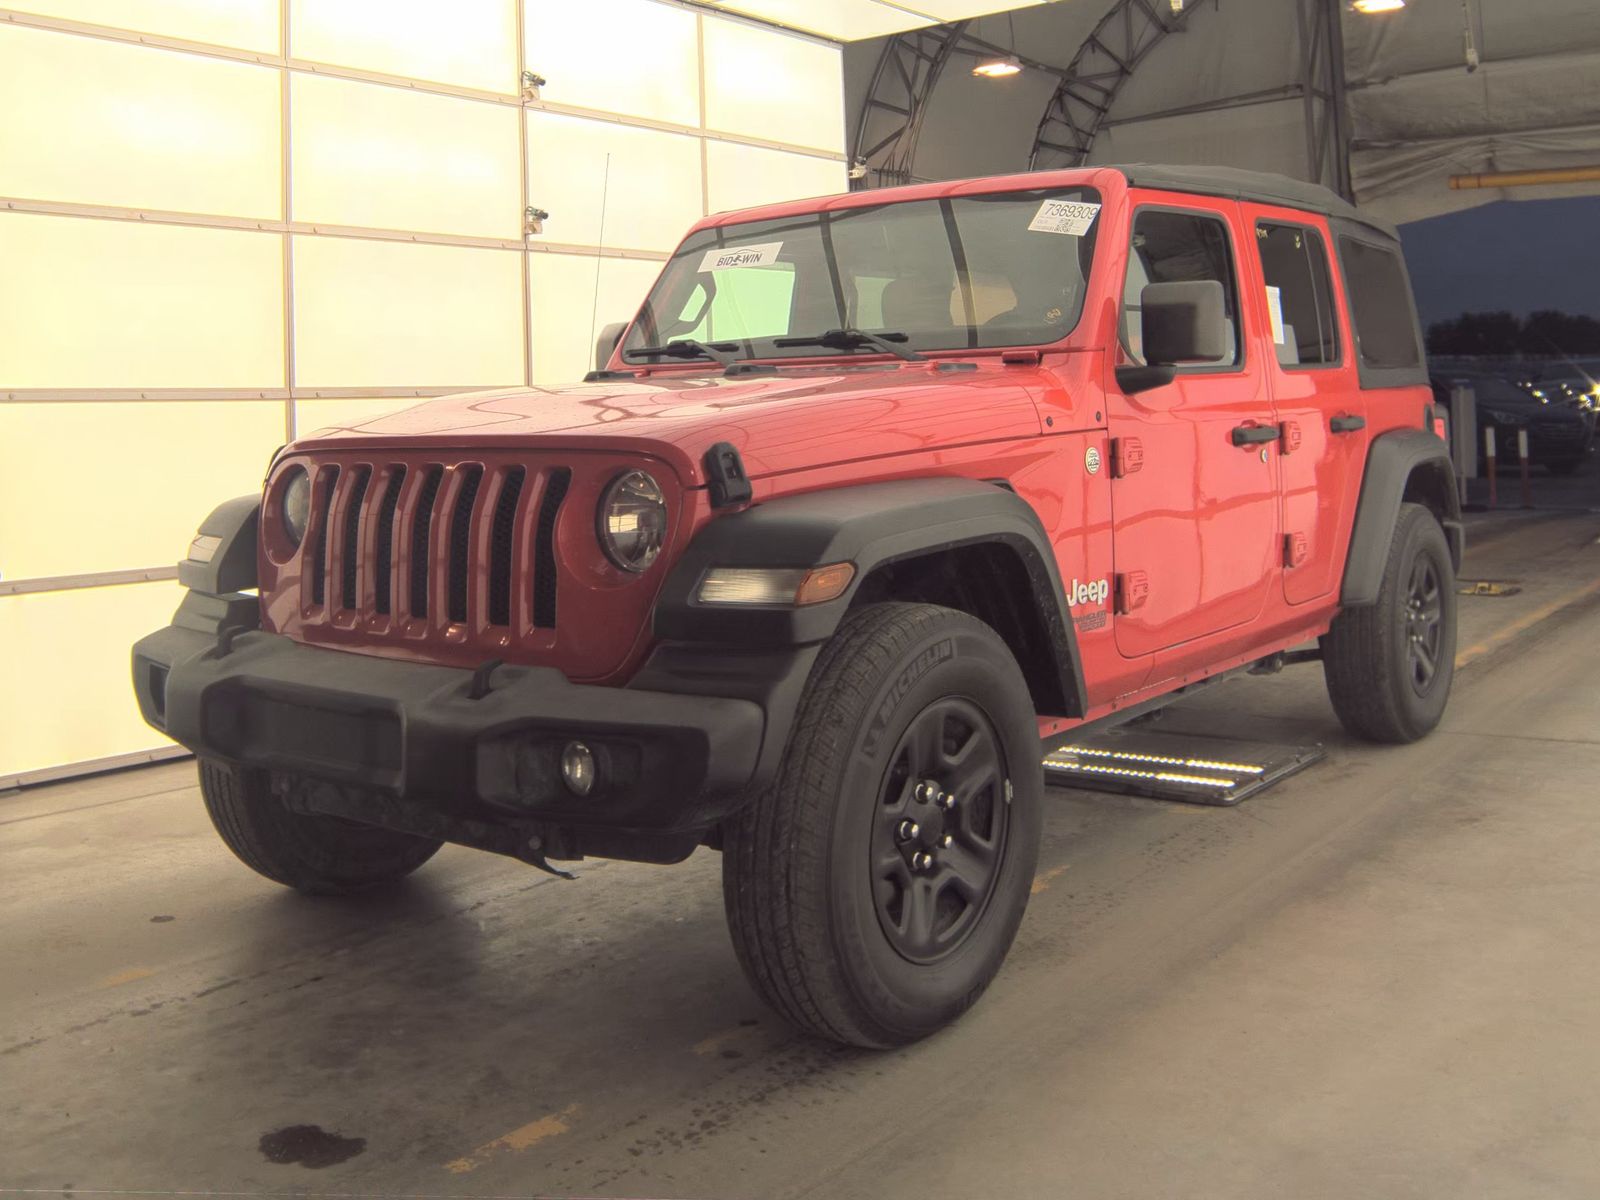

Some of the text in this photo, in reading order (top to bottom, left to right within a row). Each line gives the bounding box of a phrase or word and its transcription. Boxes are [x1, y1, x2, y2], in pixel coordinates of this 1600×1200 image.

[1044, 203, 1099, 220] 7369309
[716, 253, 763, 266] BID WIN
[1066, 578, 1108, 607] Jeep
[878, 638, 953, 724] MICHELIN
